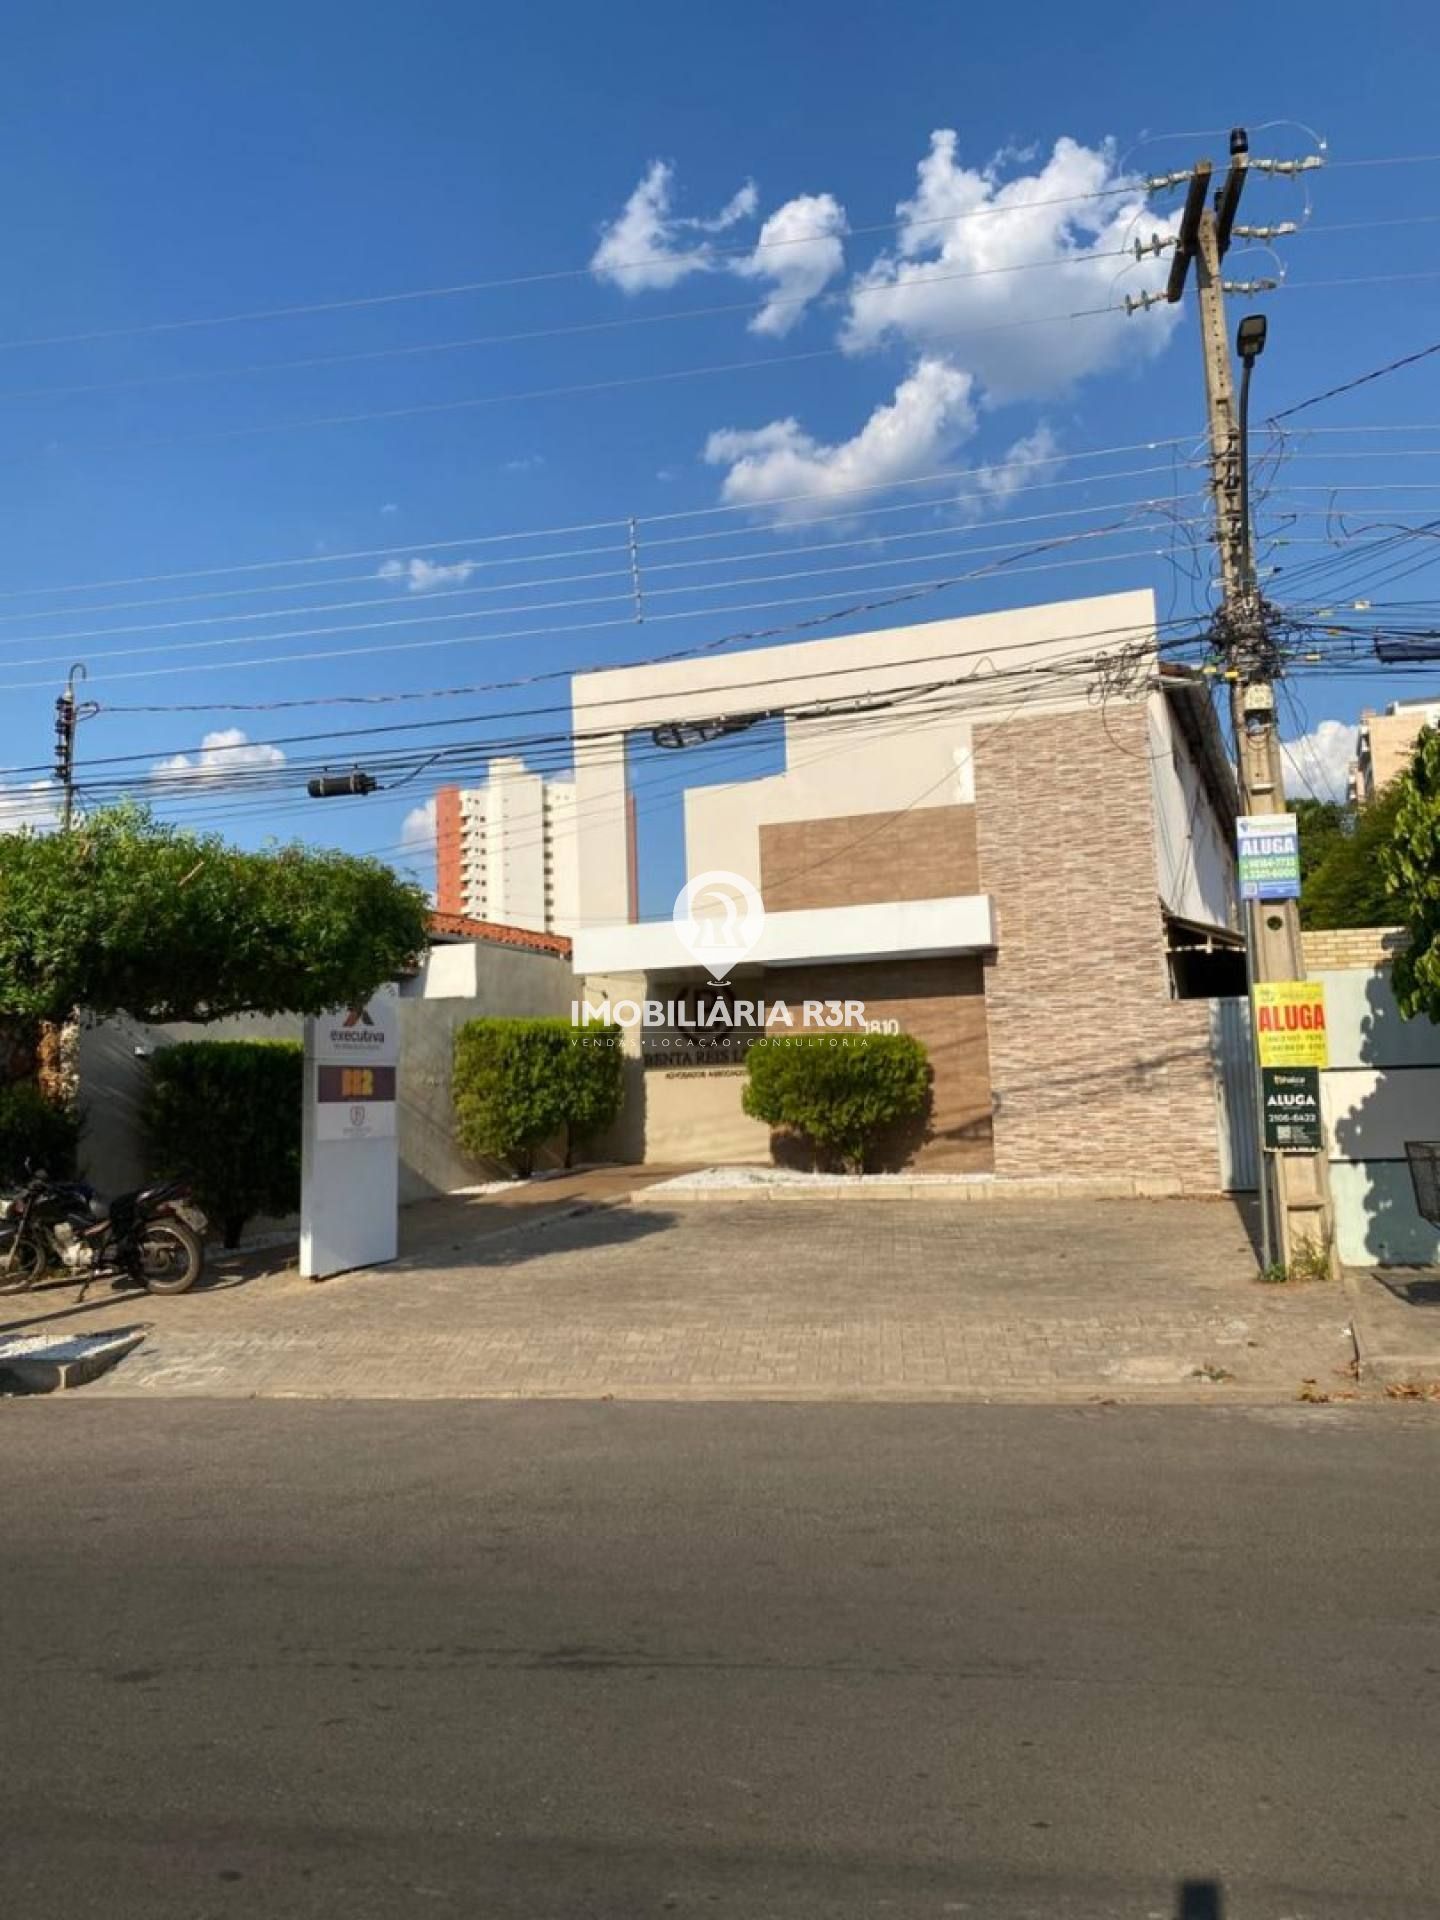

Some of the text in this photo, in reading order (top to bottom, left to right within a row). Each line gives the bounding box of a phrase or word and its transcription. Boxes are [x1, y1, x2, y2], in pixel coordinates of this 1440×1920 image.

[1240, 836, 1296, 856] ALUGA
[1258, 1004, 1326, 1032] ALUGA
[330, 1029, 385, 1043] executiva
[1267, 1094, 1316, 1106] ALUGA
